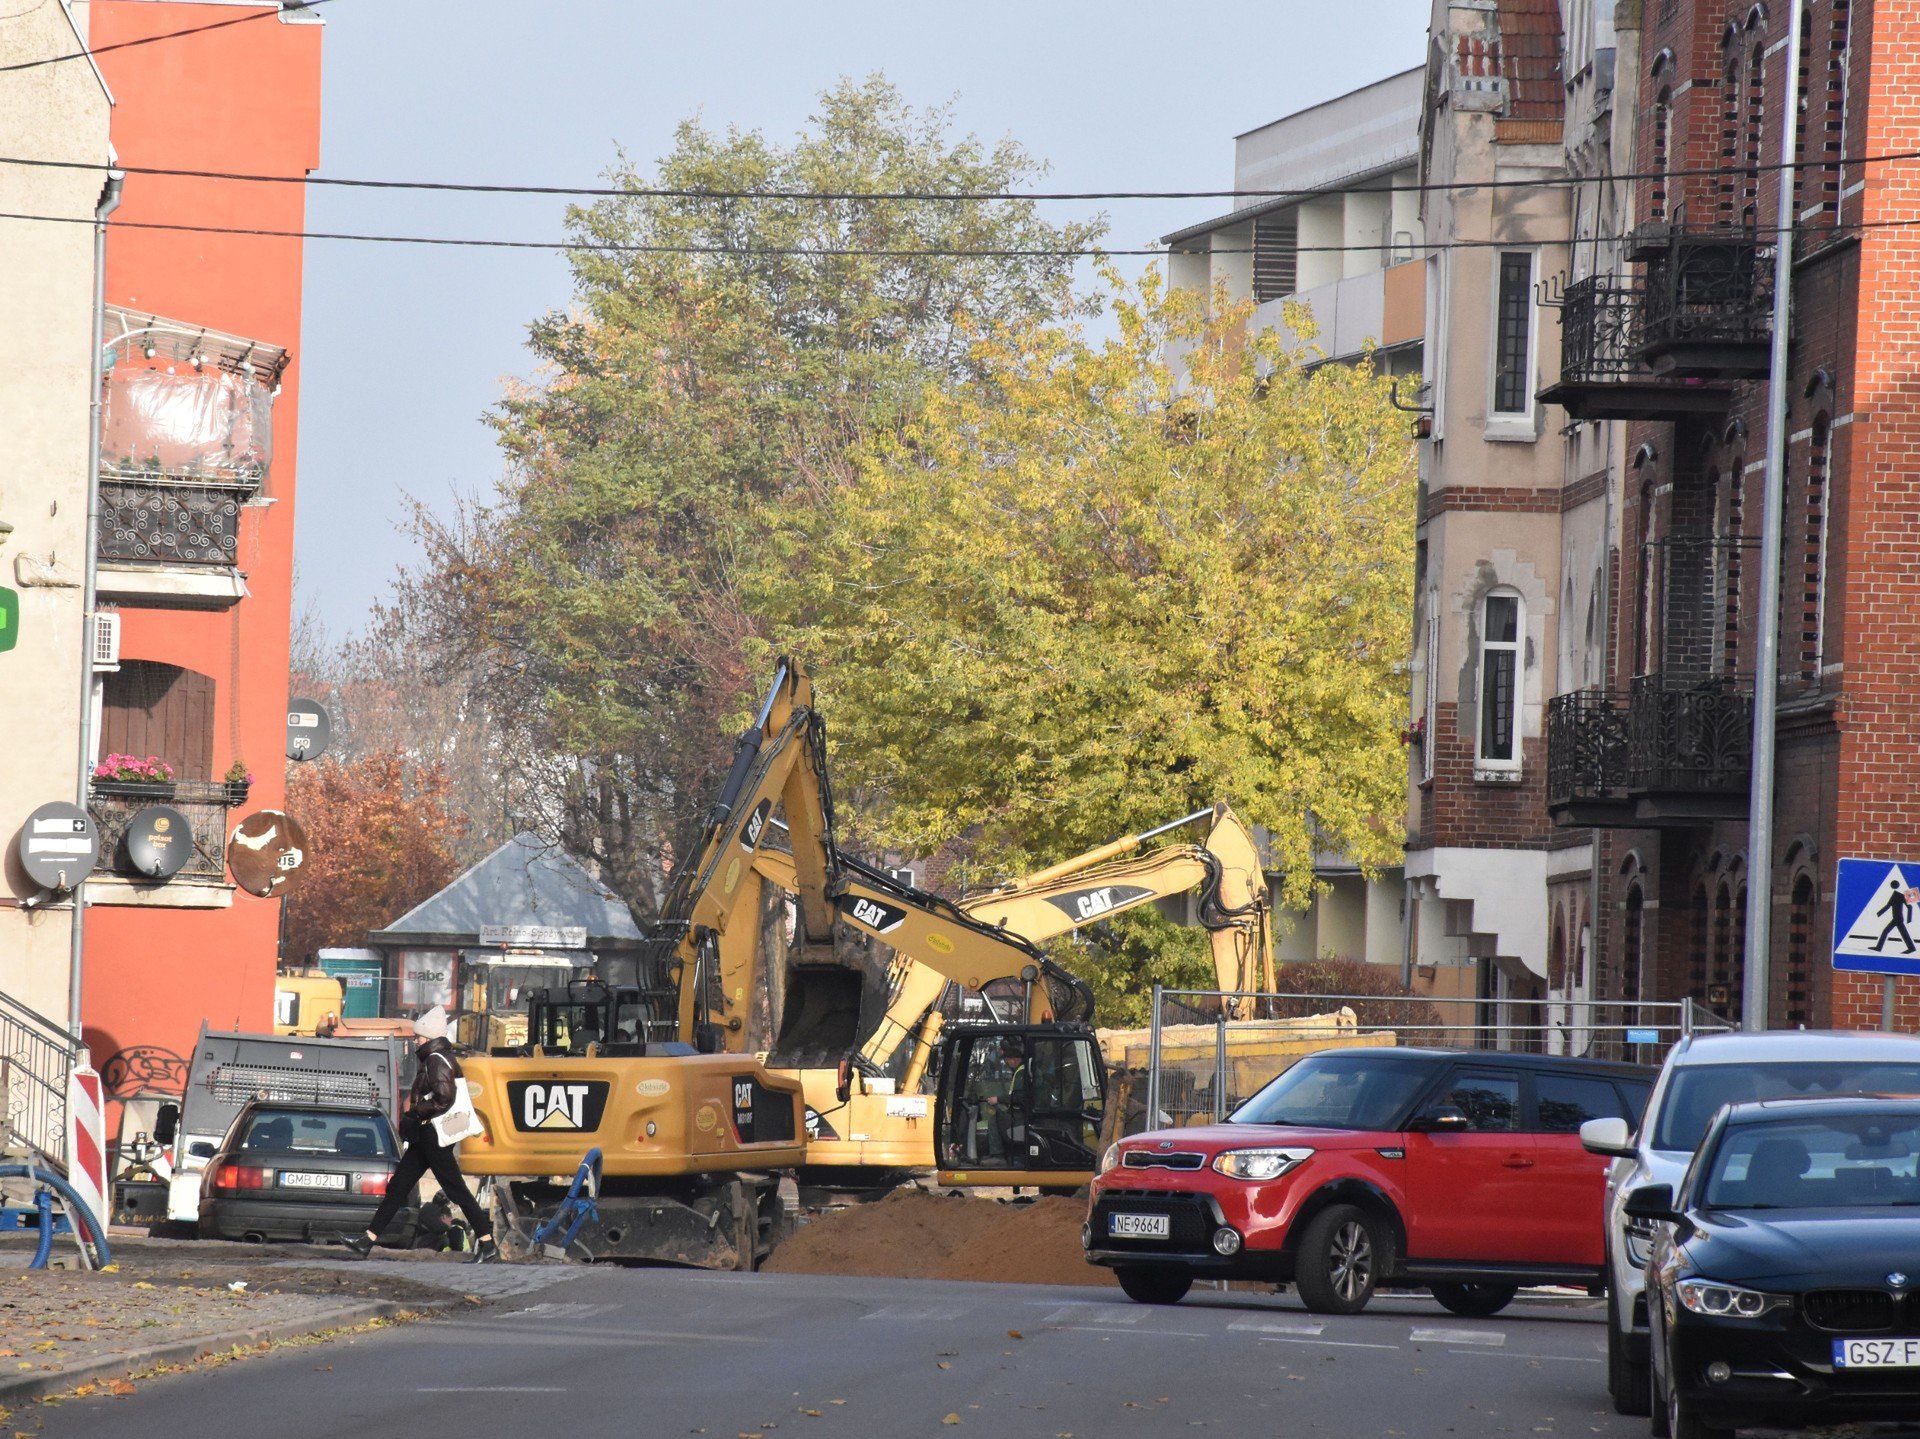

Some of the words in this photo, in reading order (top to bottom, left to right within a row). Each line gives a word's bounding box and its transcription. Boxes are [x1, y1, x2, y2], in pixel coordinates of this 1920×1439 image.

[748, 807, 762, 843] CAT
[853, 899, 887, 927] CAT
[1077, 887, 1113, 918] CAT
[418, 969, 444, 981] abc
[524, 1084, 589, 1128] CAT
[735, 1083, 753, 1108] CAT
[287, 1173, 312, 1185] GMB
[315, 1174, 344, 1187] 02LU
[1117, 1216, 1131, 1232] NE
[1134, 1217, 1165, 1233] 9664J
[1850, 1341, 1896, 1365] GSZ
